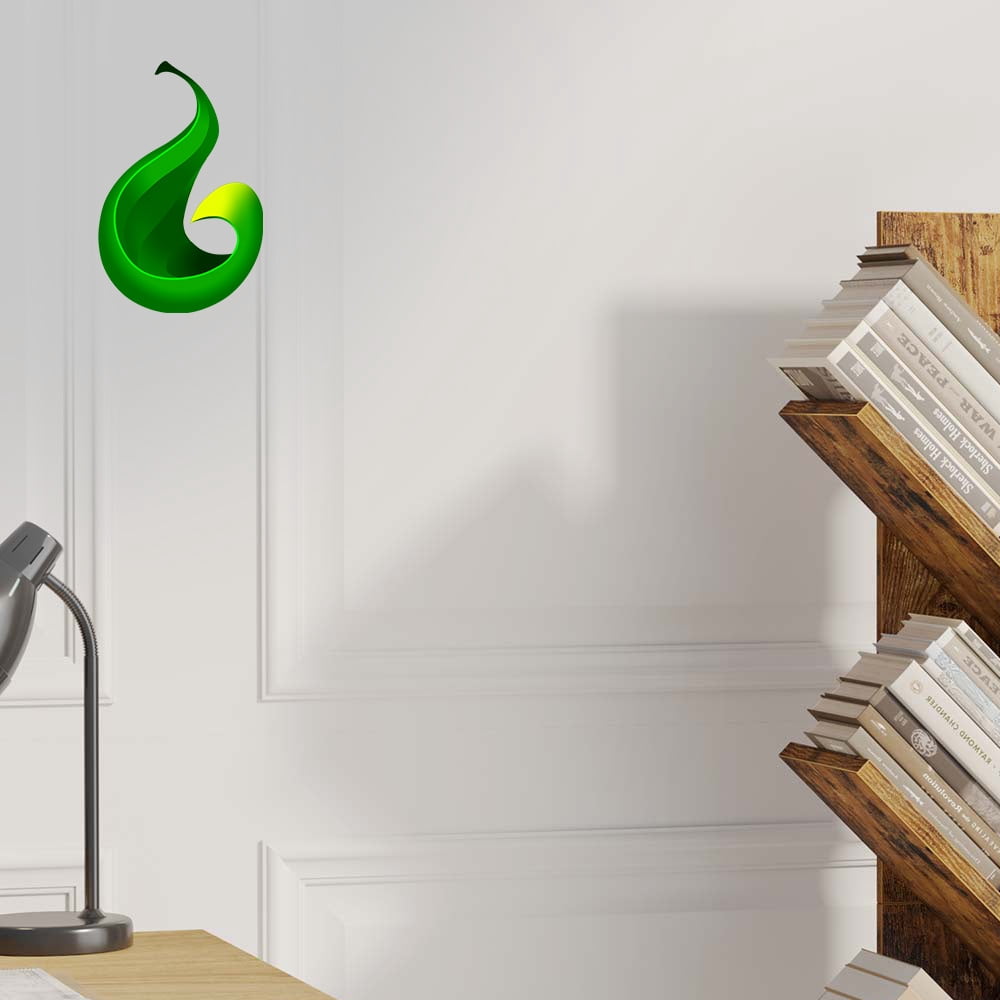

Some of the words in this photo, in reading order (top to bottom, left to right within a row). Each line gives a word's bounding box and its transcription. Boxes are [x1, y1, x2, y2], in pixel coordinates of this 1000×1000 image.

[896, 333, 948, 387] PEACE
[929, 407, 960, 440] Holmes
[957, 398, 997, 439] WAR
[910, 427, 941, 459] Holmes
[957, 436, 993, 474] Sherlock
[938, 456, 973, 493] Sherlock
